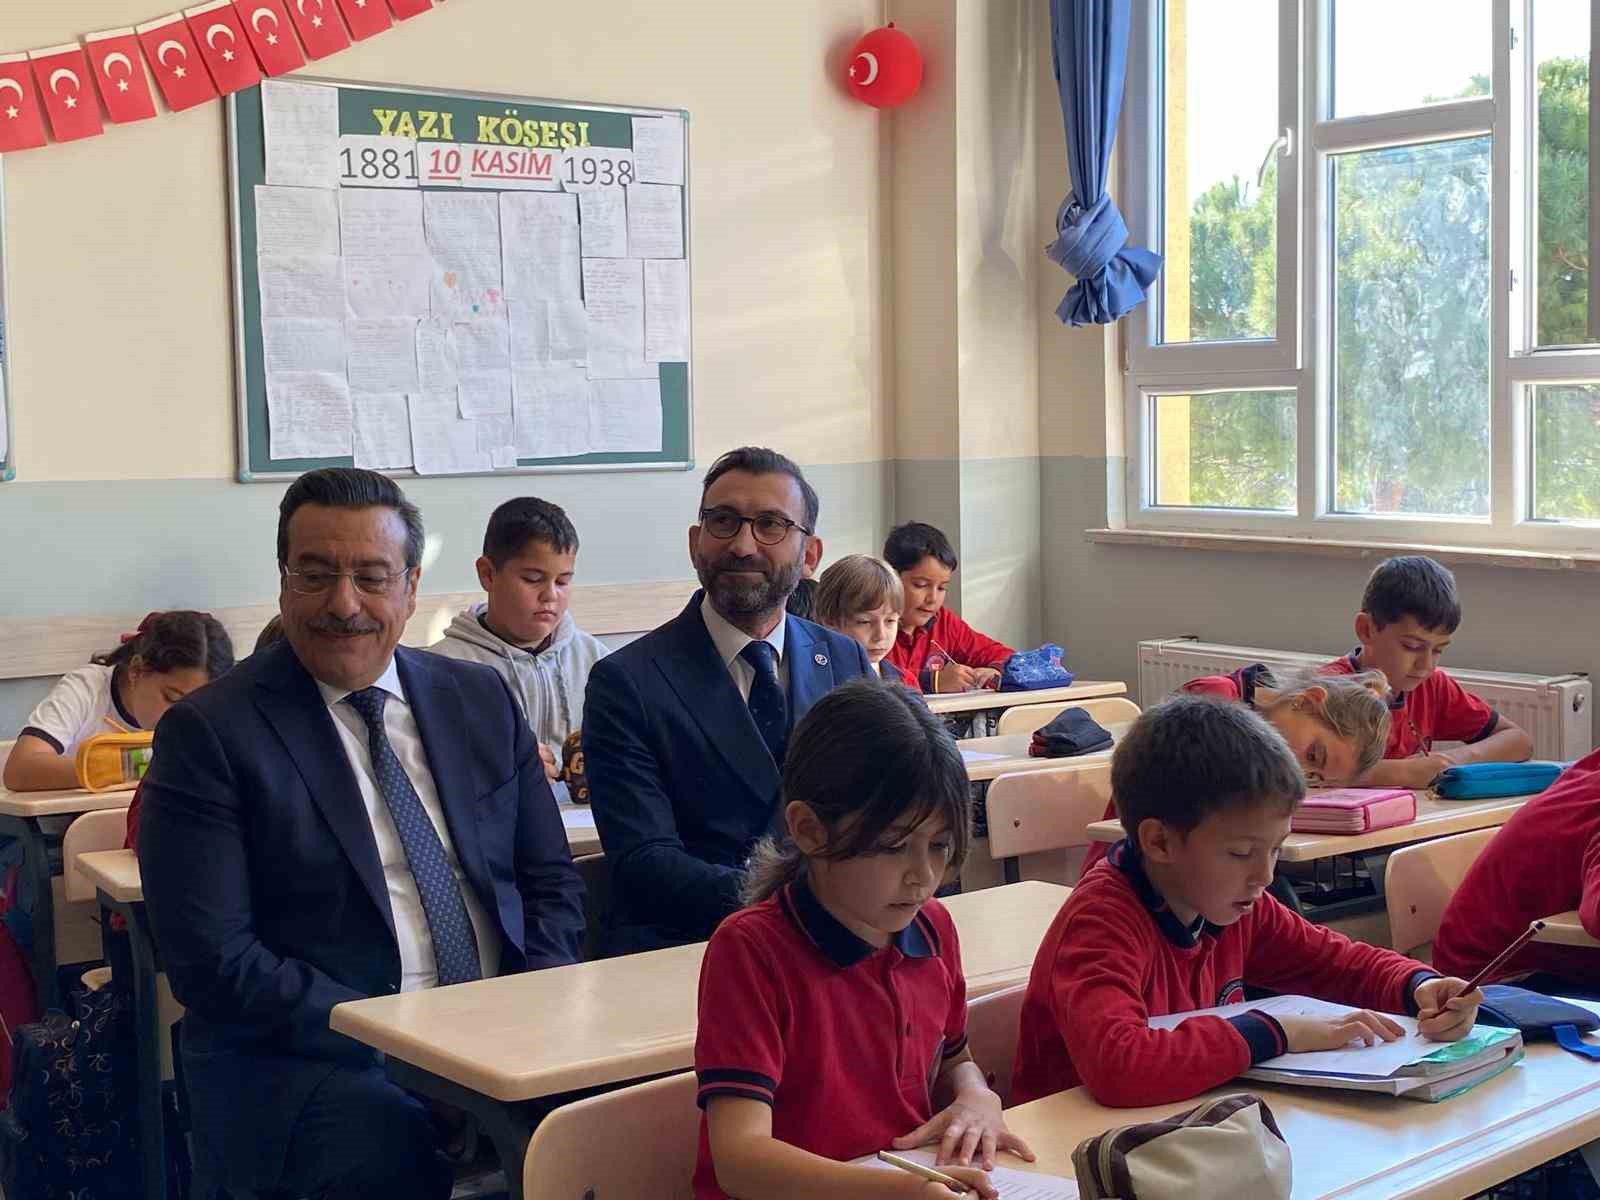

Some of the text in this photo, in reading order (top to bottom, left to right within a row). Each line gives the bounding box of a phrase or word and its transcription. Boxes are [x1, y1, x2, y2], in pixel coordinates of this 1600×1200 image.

[372, 108, 454, 140] YAZI
[340, 147, 420, 179] 1881
[429, 149, 552, 177] 10 KASIM
[564, 156, 633, 187] 1938
